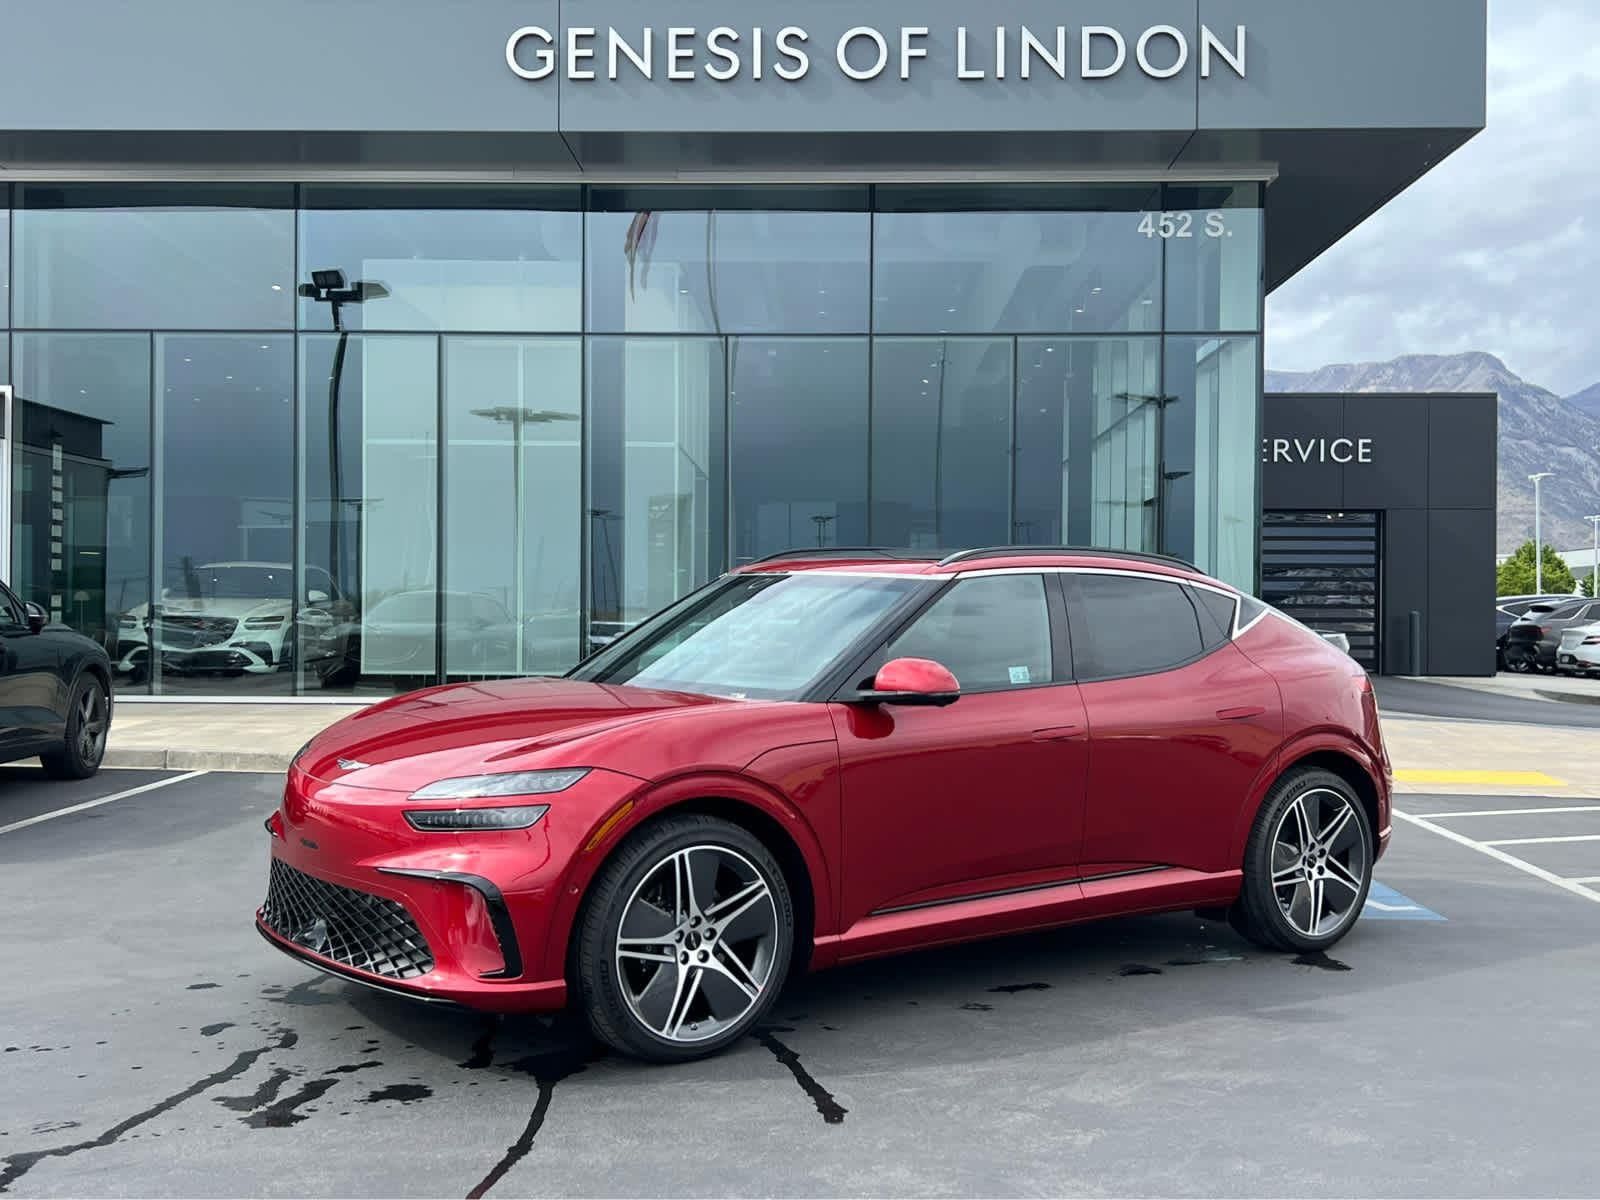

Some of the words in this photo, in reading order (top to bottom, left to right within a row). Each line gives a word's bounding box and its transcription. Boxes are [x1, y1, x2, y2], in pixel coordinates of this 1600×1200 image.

[505, 25, 810, 81] GENESIS
[836, 25, 929, 80] OF
[956, 24, 1247, 79] LINDON
[1137, 211, 1193, 238] 452
[1204, 211, 1233, 238] S.
